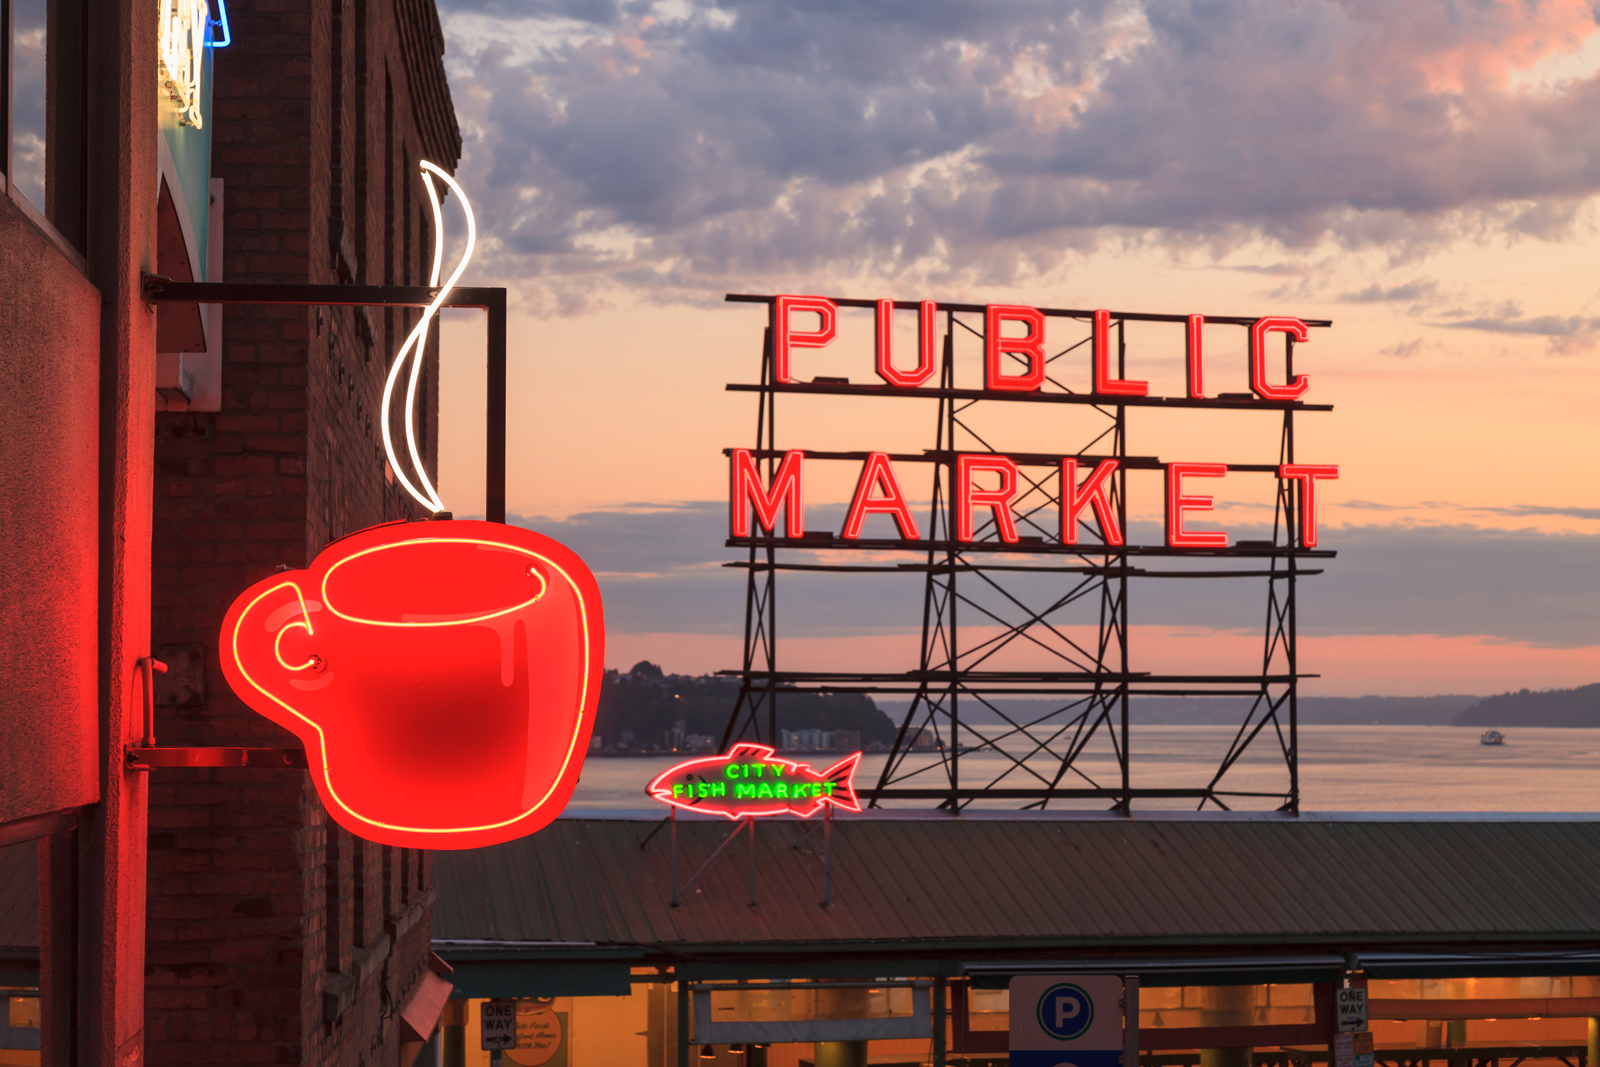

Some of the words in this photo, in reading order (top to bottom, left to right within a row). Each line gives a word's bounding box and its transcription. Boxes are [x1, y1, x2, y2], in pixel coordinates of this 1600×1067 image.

[775, 294, 1310, 400] PUBLIC
[732, 448, 1340, 549] MARKET
[725, 763, 786, 779] CITY
[672, 782, 727, 799] FISH
[734, 782, 837, 799] MARKET
[1340, 990, 1363, 1002] ONE
[485, 1005, 512, 1017] ONE
[1055, 996, 1081, 1028] P
[1340, 1003, 1364, 1014] WAY
[484, 1019, 512, 1030] WAY
